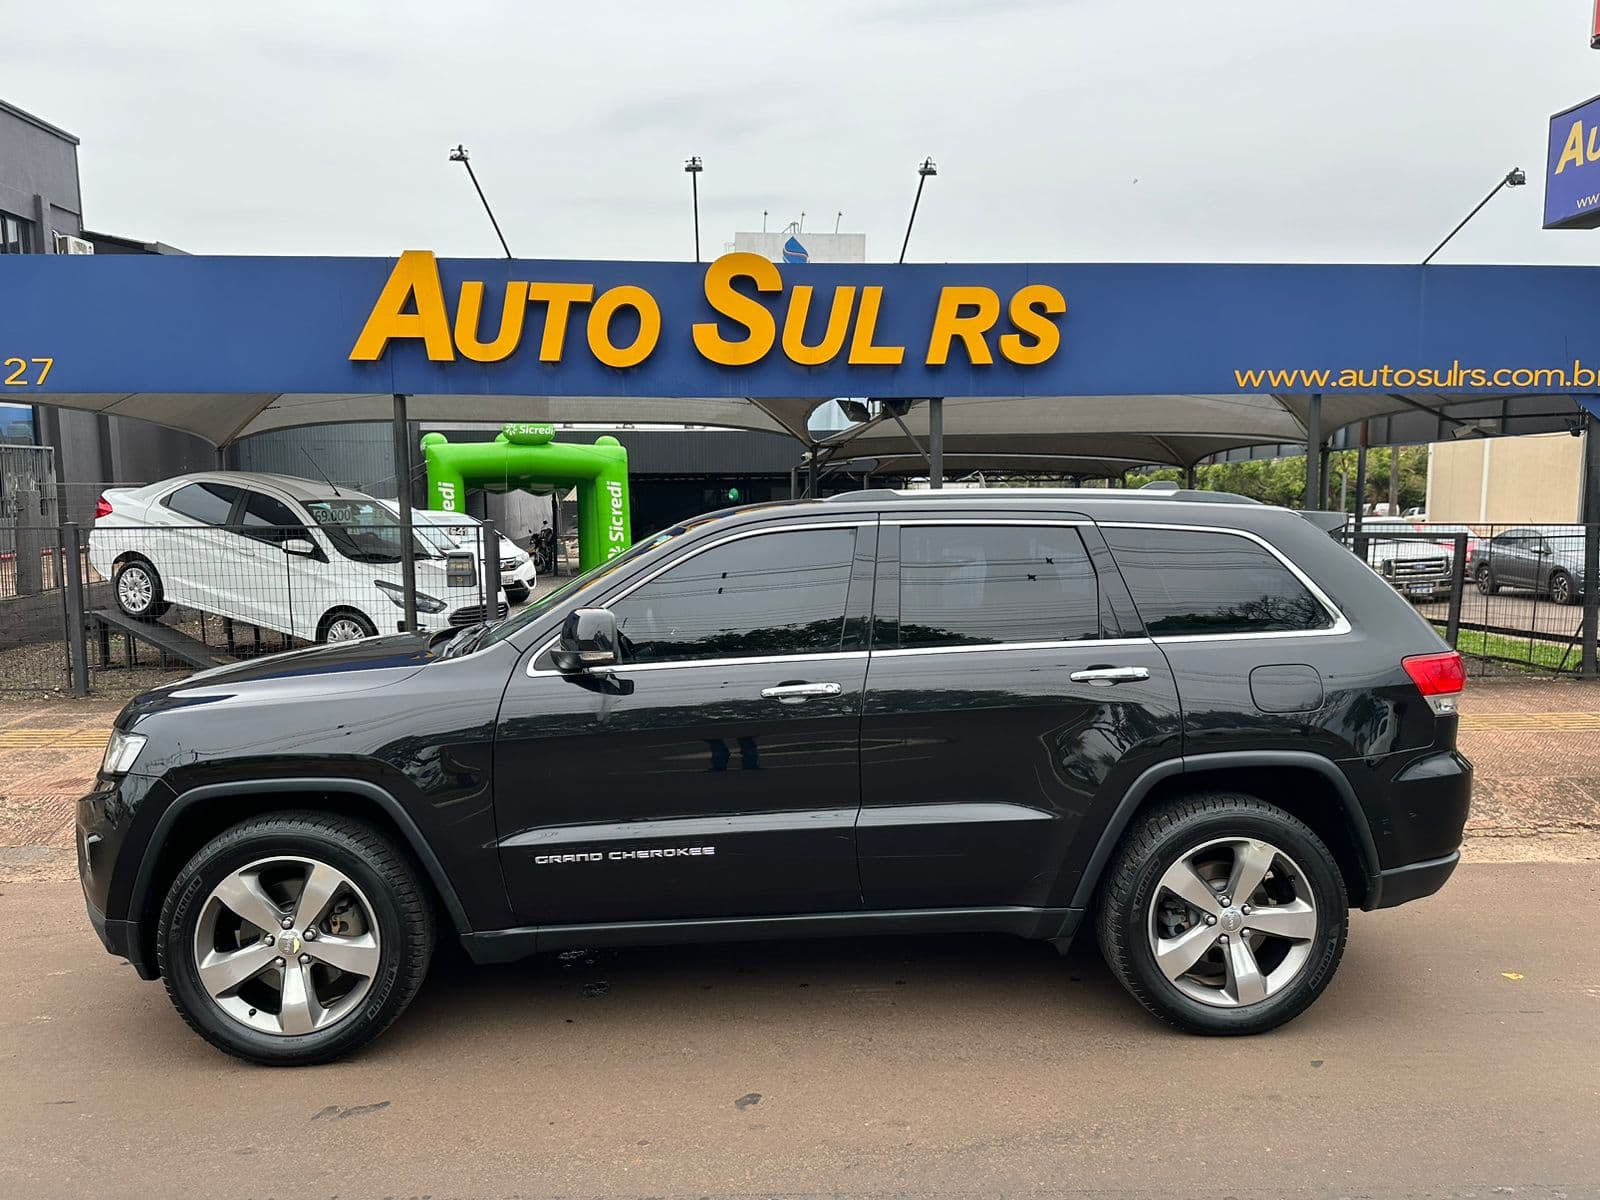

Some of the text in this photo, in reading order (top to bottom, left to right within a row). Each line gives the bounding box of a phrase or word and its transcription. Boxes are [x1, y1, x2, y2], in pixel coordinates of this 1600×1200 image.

[925, 284, 1066, 366] RS
[4, 357, 54, 385] 27
[1234, 359, 1600, 387] www.autosulrs.com.b
[519, 425, 554, 435] Sicredi
[606, 480, 625, 542] Sicredi
[534, 846, 715, 865] GRAND CHEROKEE
[173, 876, 202, 927] MICHELIN
